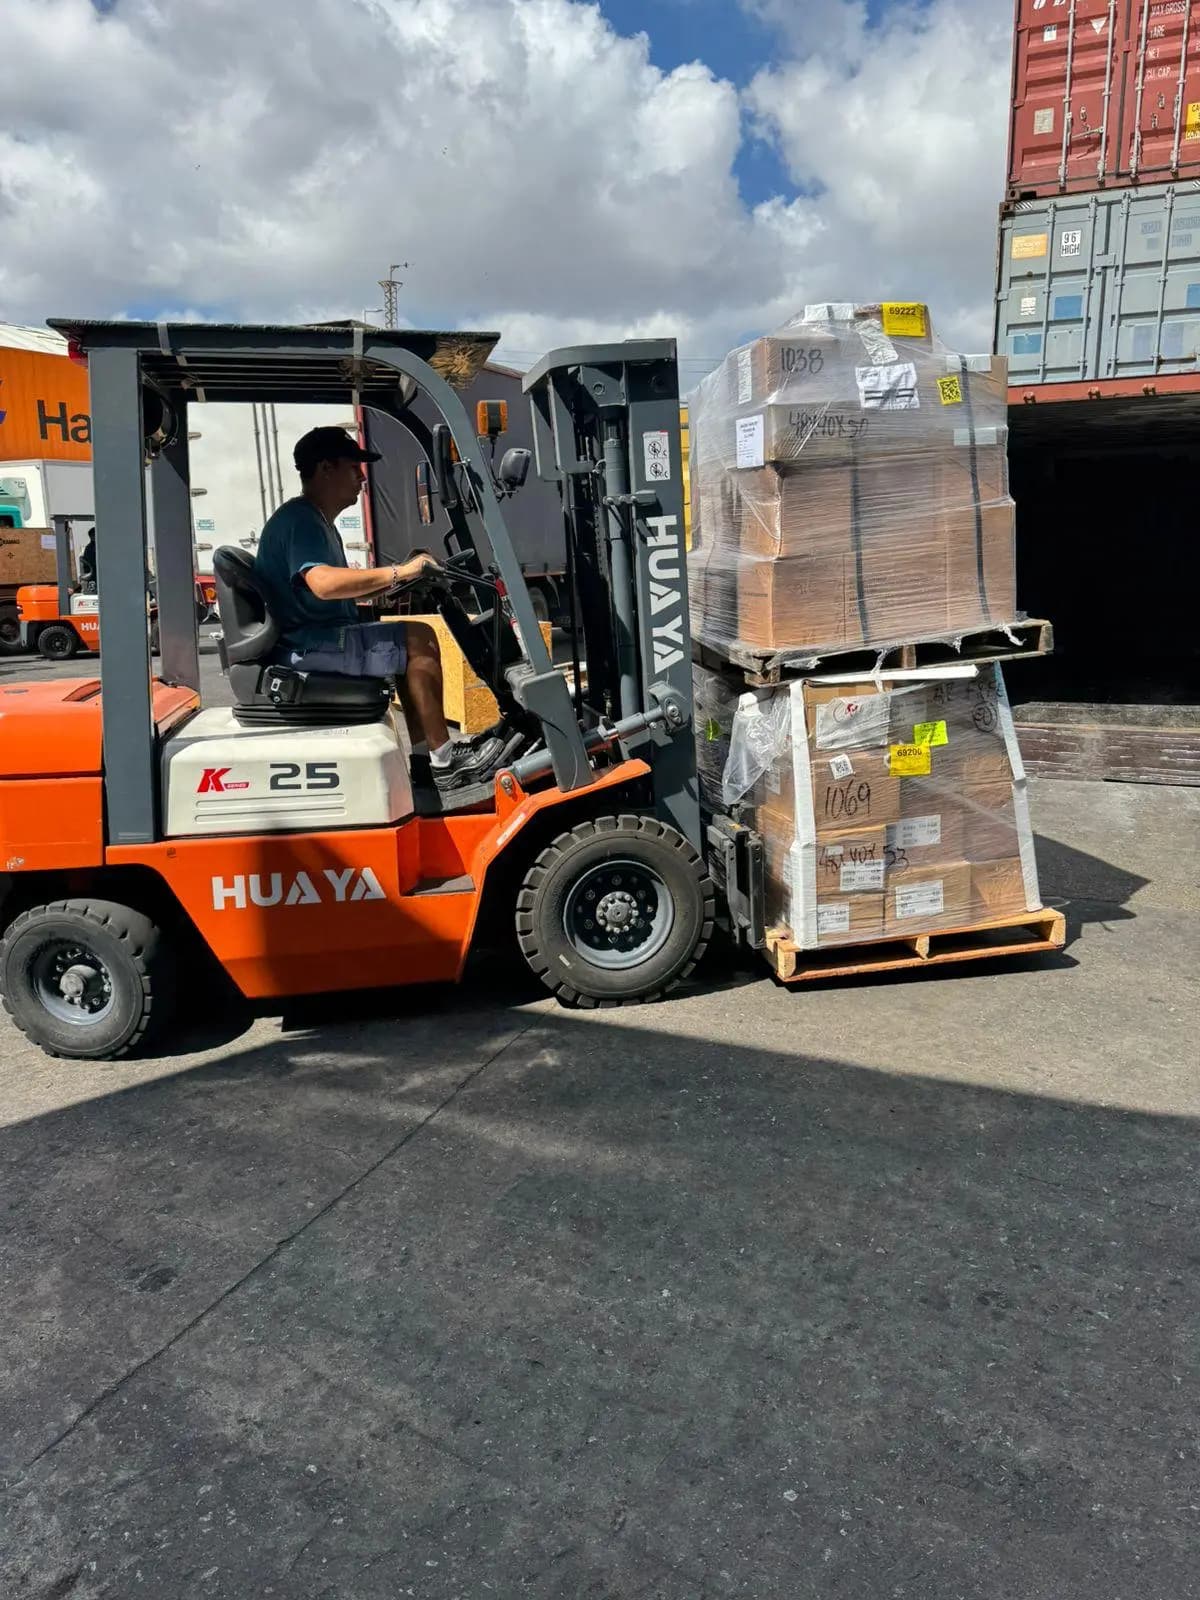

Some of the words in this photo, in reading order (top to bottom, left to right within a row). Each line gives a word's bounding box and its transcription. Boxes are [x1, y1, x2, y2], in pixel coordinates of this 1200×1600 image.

[1061, 243, 1080, 255] HIGH
[781, 347, 824, 374] 1038
[646, 514, 685, 675] HUAYA
[196, 767, 232, 793] K
[269, 762, 340, 790] 25
[825, 779, 871, 819] 1069
[211, 867, 387, 911] HUAYA
